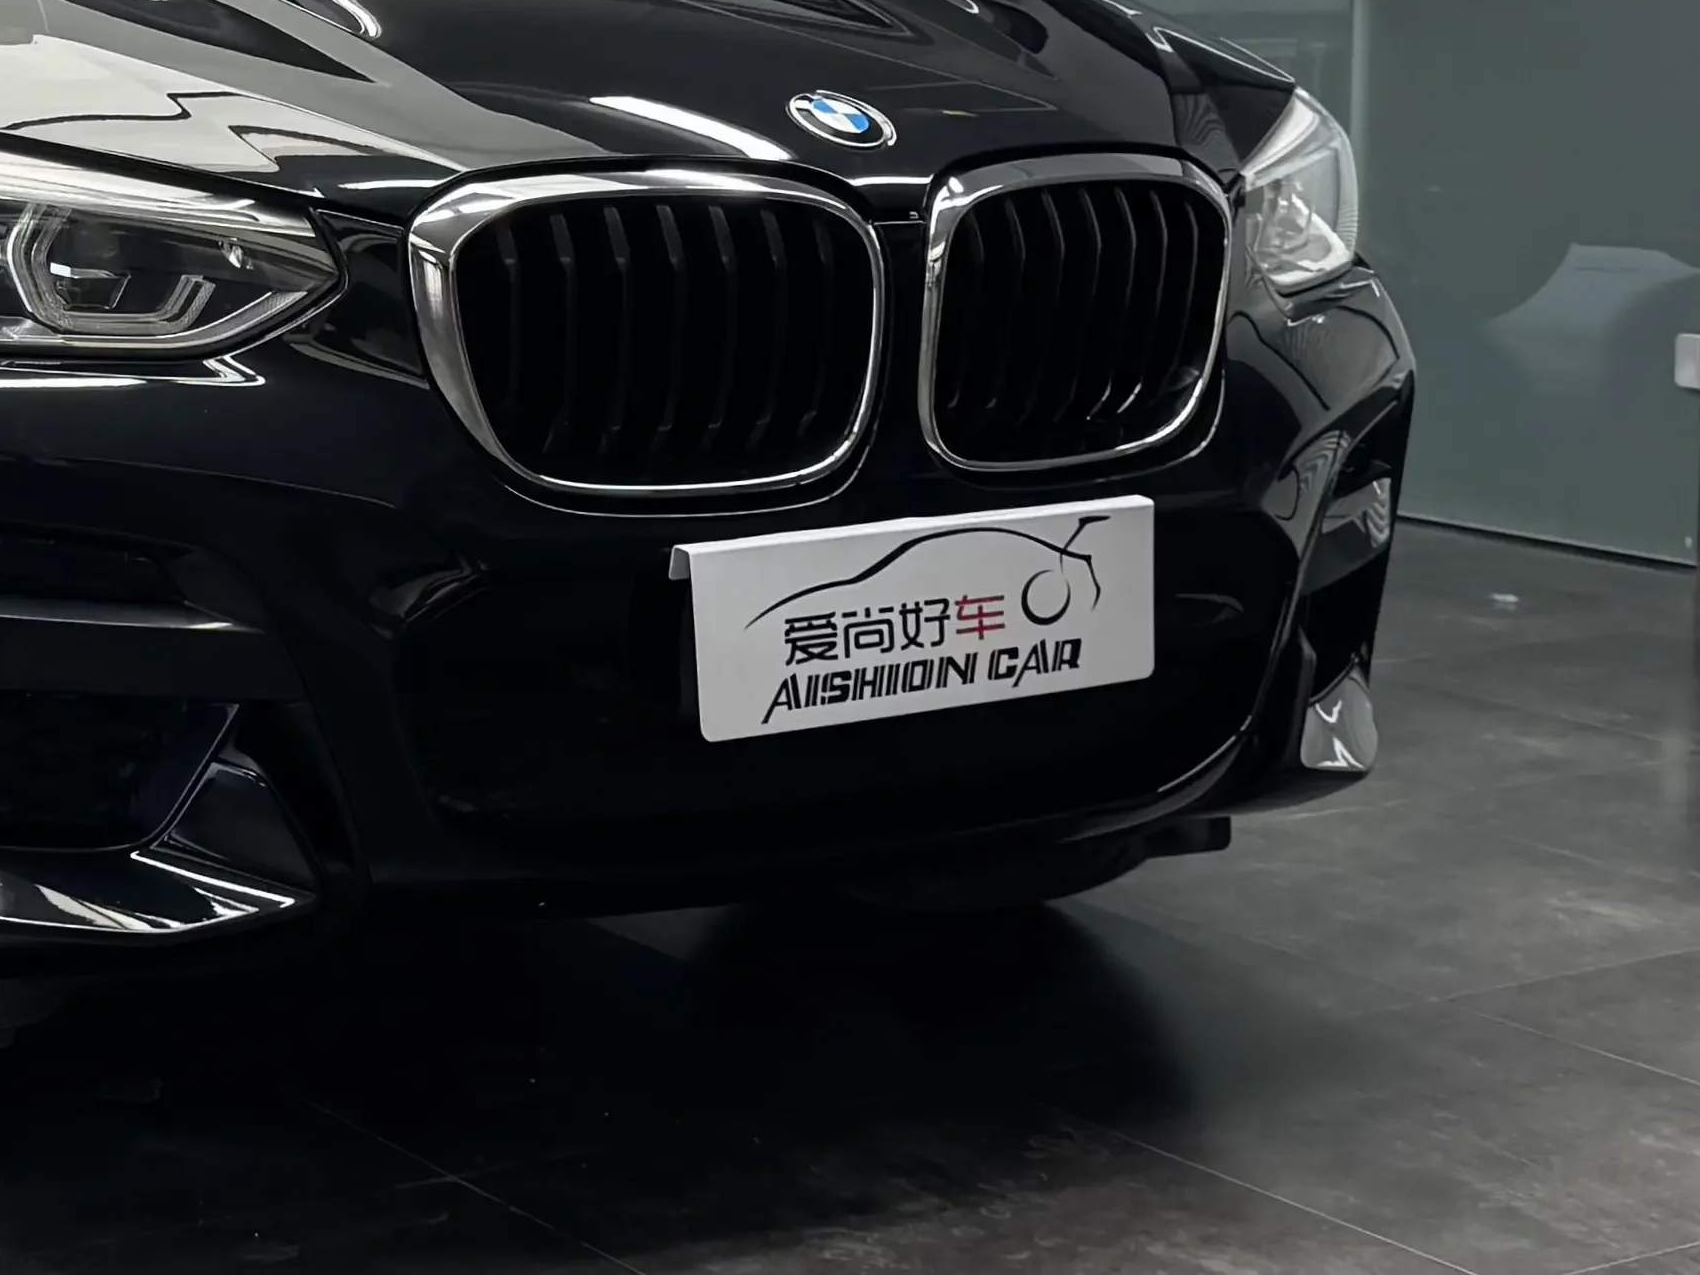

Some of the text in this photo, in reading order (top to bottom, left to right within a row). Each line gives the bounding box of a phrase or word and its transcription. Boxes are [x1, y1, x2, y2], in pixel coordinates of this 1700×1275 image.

[784, 595, 1005, 666] 爱尚好车
[761, 638, 1082, 724] AISHION CAR
